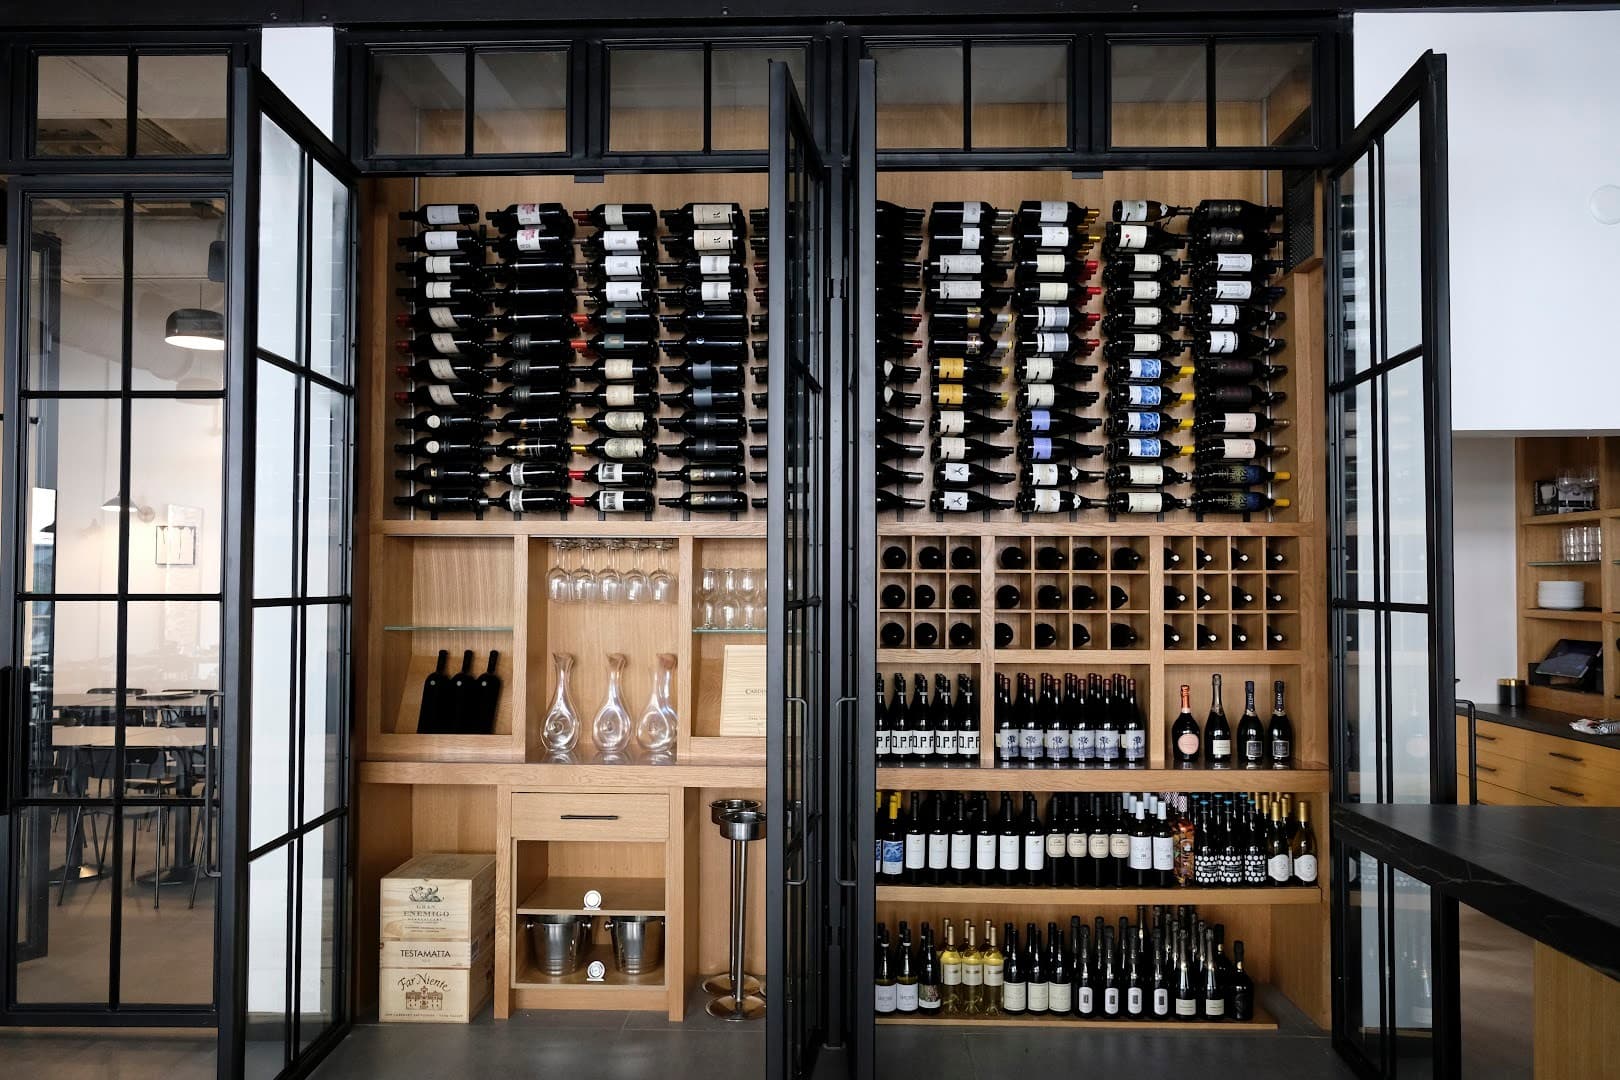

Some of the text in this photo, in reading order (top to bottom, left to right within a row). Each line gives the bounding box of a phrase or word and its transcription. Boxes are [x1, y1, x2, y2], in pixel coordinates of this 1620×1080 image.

[400, 949, 451, 958] TESTAMATTA
[397, 972, 451, 992] Far Niente
